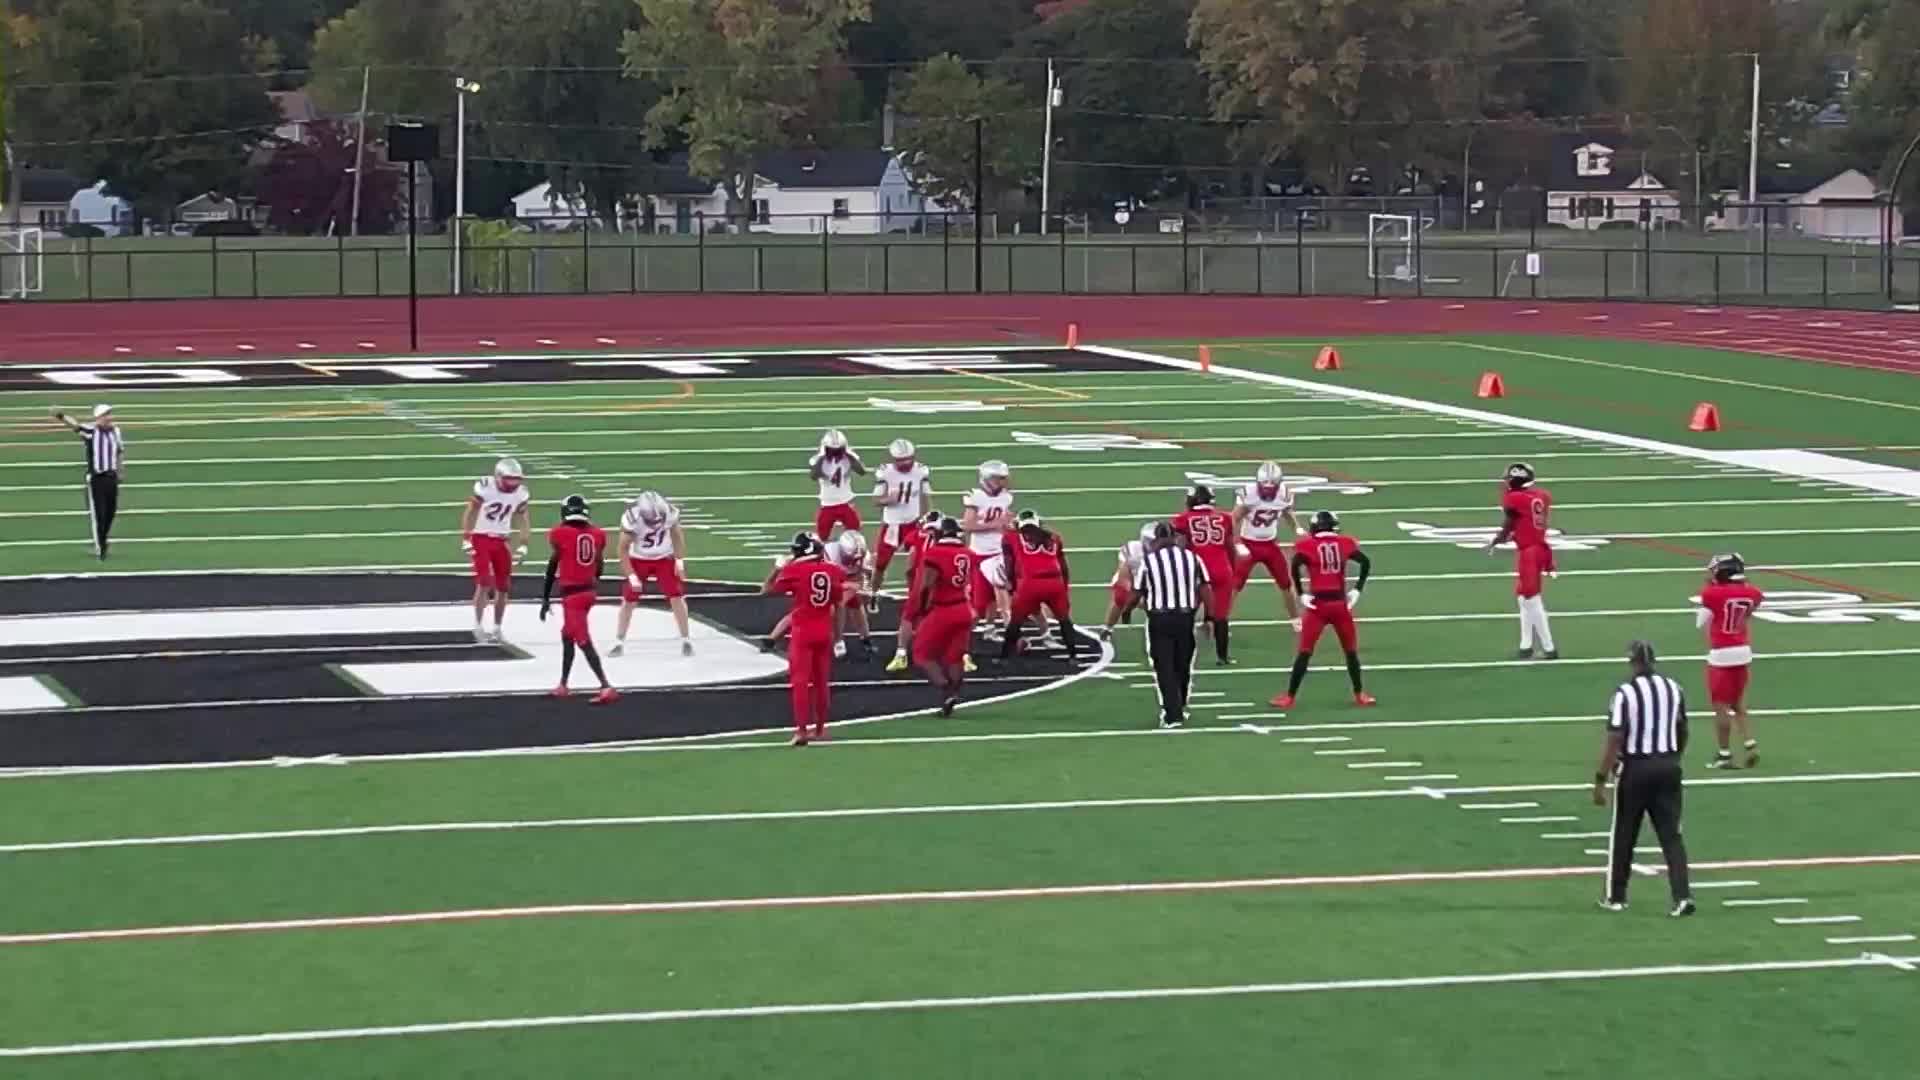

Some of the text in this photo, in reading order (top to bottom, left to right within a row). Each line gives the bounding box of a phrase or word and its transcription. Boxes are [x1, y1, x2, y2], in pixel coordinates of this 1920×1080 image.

[831, 468, 842, 488] 4
[896, 482, 912, 504] 11
[485, 503, 512, 521] 21
[641, 529, 666, 548] 51
[1188, 515, 1226, 546] 55
[576, 533, 596, 566] 0
[951, 553, 971, 588] 3
[810, 571, 832, 606] 9
[1721, 596, 1755, 634] 17
